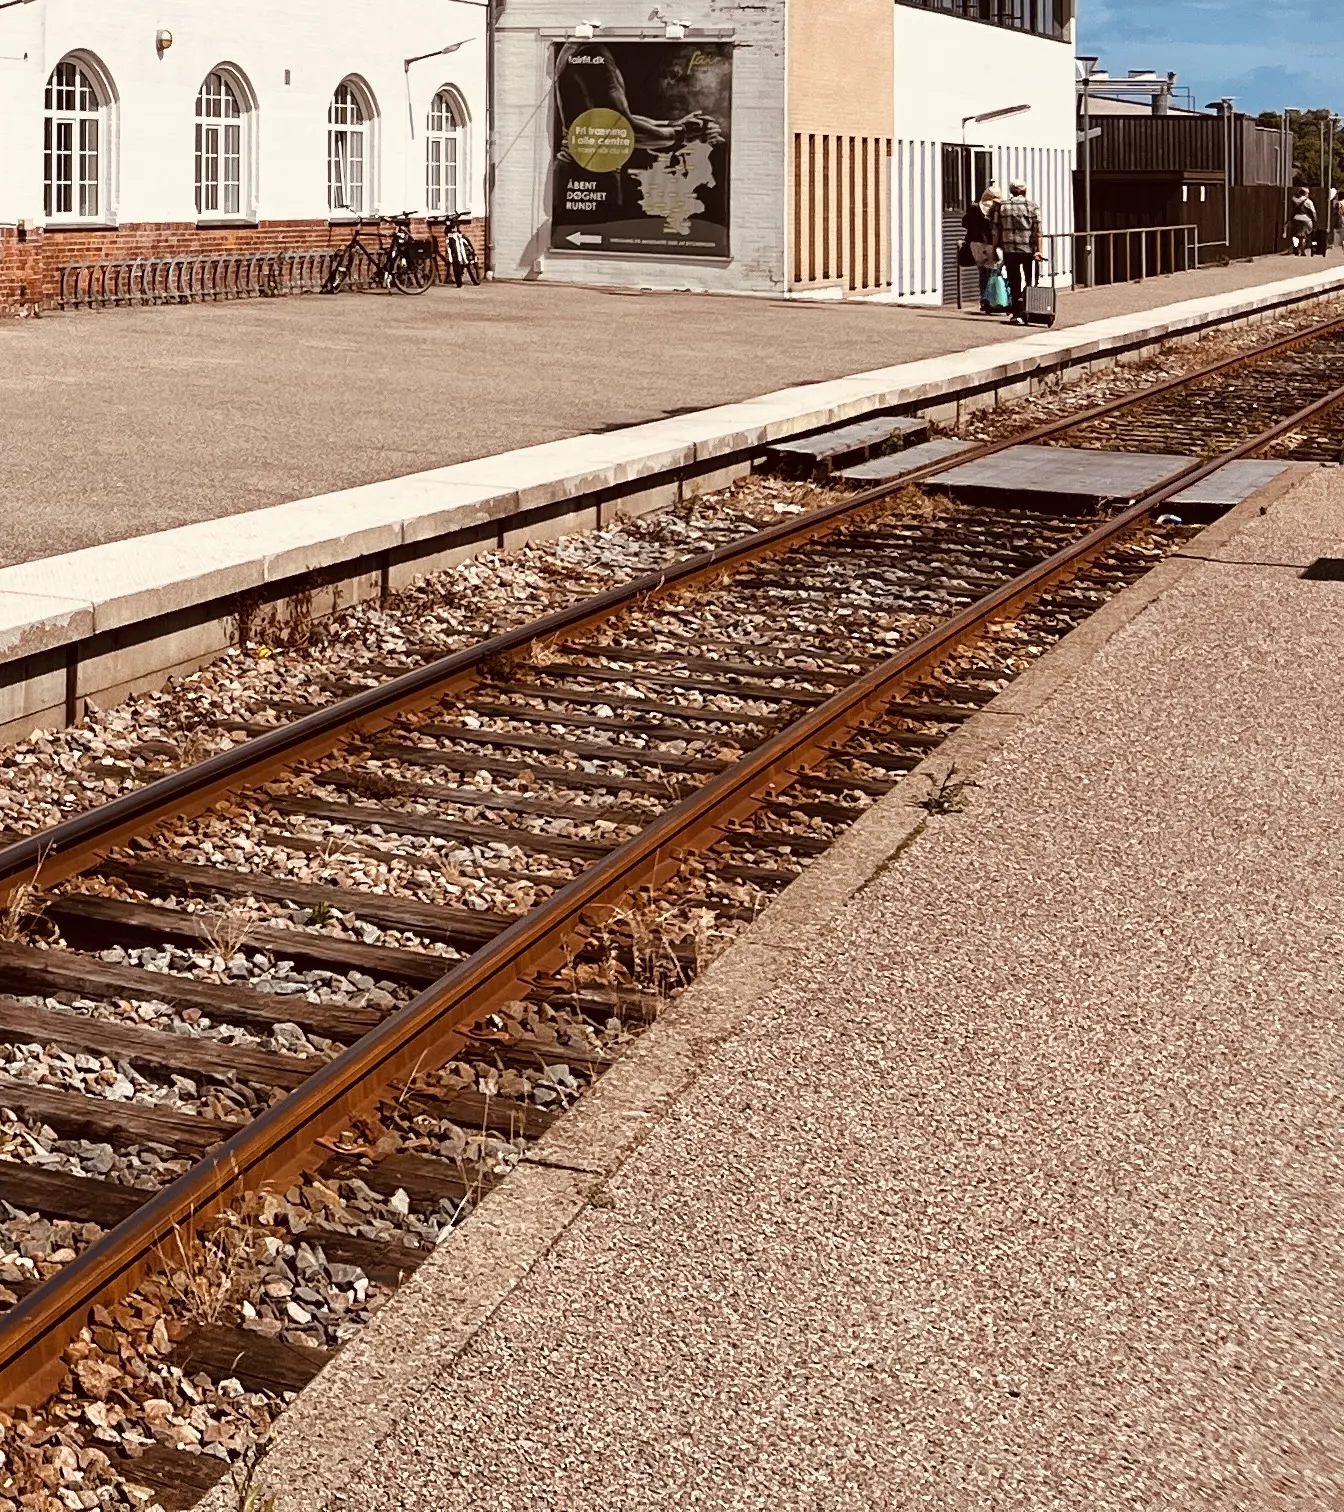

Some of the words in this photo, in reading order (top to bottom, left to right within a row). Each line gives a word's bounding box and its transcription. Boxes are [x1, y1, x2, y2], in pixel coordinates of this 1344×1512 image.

[577, 136, 595, 145] alle
[597, 136, 631, 146] centre
[567, 178, 597, 190] ÅBENT
[566, 191, 607, 202] DØGNET
[565, 201, 597, 211] RUNDT
